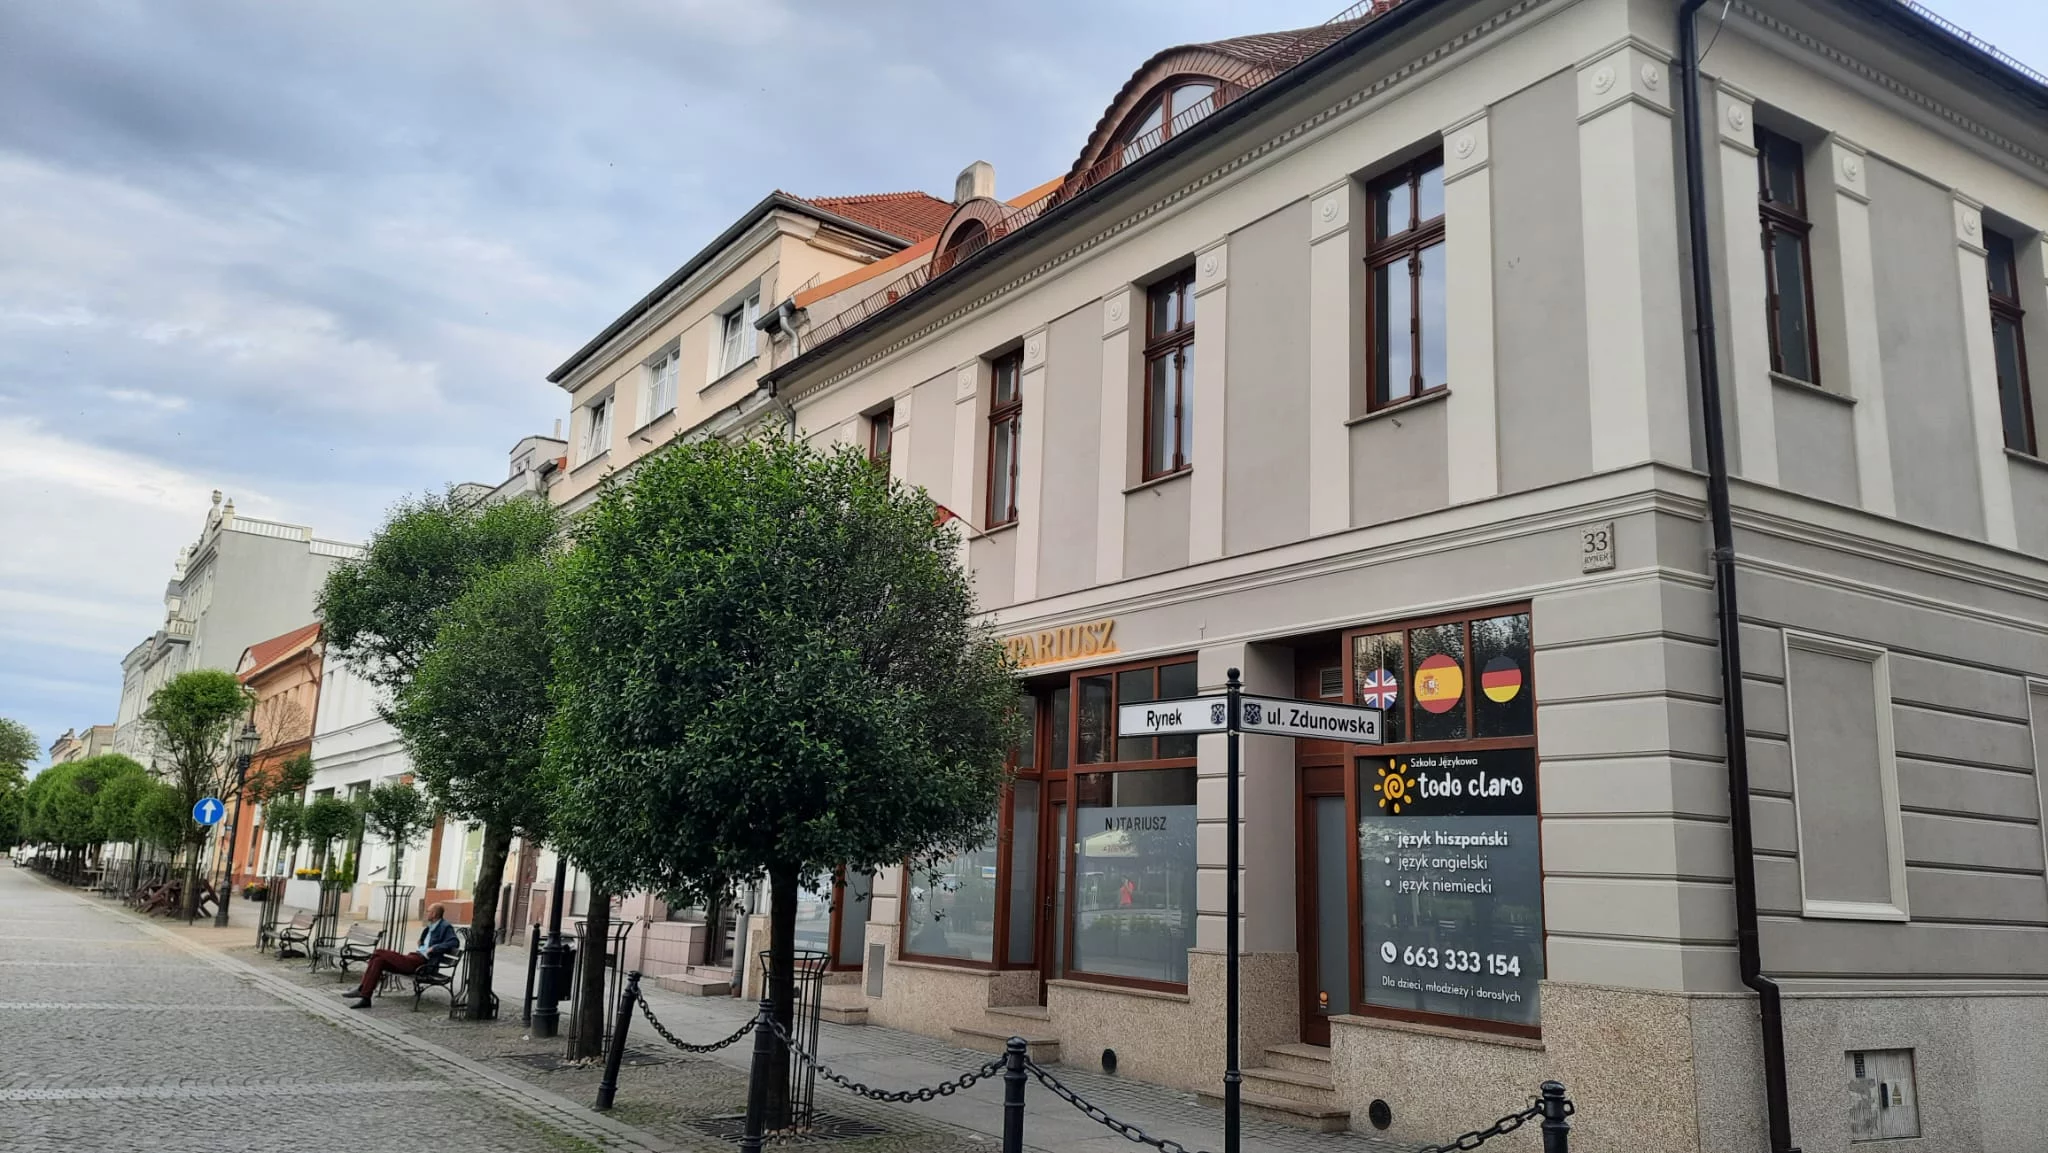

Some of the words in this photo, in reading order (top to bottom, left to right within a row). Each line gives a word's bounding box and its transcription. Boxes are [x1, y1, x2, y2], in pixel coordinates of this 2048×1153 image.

[1584, 531, 1608, 553] 33
[1000, 619, 1116, 668] TARIUSZ
[1147, 709, 1182, 731] Rynek
[1268, 711, 1285, 726] ul.
[1289, 709, 1375, 735] Zdunowska
[1410, 758, 1437, 768] Szkoła
[1438, 756, 1478, 768] Językowa
[1417, 772, 1462, 799] todo
[1468, 771, 1523, 797] claro
[1398, 831, 1431, 848] język
[1435, 831, 1508, 849] hiszpański
[1398, 854, 1429, 871] język
[1432, 854, 1488, 872] angielski
[1399, 877, 1430, 894] język
[1433, 879, 1492, 894] niemiecki
[1403, 945, 1439, 969] 663
[1445, 949, 1481, 973] 333
[1487, 953, 1521, 977] 154
[1382, 975, 1395, 987] Dla
[1397, 979, 1424, 991] dzieci,
[1425, 981, 1469, 998] młodzieży
[1476, 986, 1521, 1003] dorosłych
